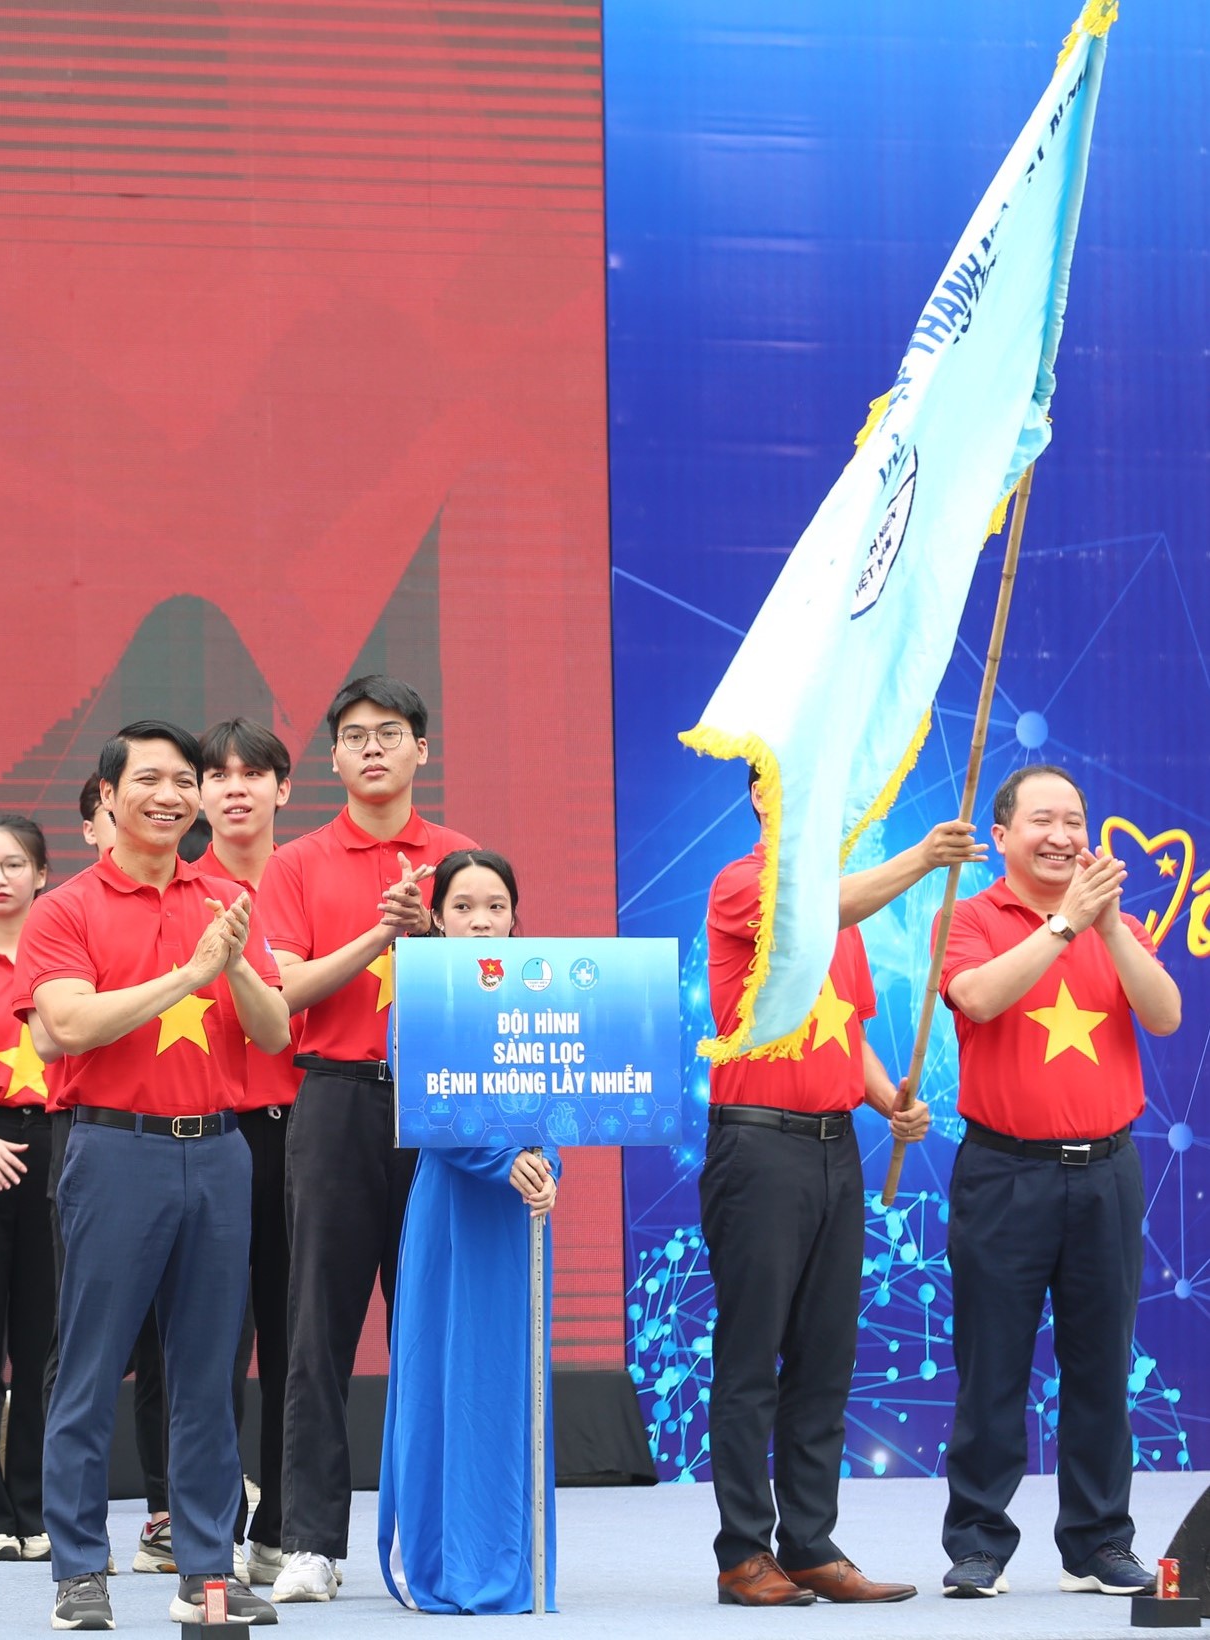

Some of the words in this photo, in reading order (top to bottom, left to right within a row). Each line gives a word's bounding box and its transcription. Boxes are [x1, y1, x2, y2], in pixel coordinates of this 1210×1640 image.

[497, 1008, 529, 1039] ĐỘI
[534, 1008, 580, 1034] HÌNH
[493, 1039, 545, 1064] SÀNG
[549, 1041, 585, 1069] LỌC
[426, 1068, 477, 1099] BỆNH
[482, 1068, 546, 1095] KHÔNG
[591, 1064, 652, 1094] NHIỄM
